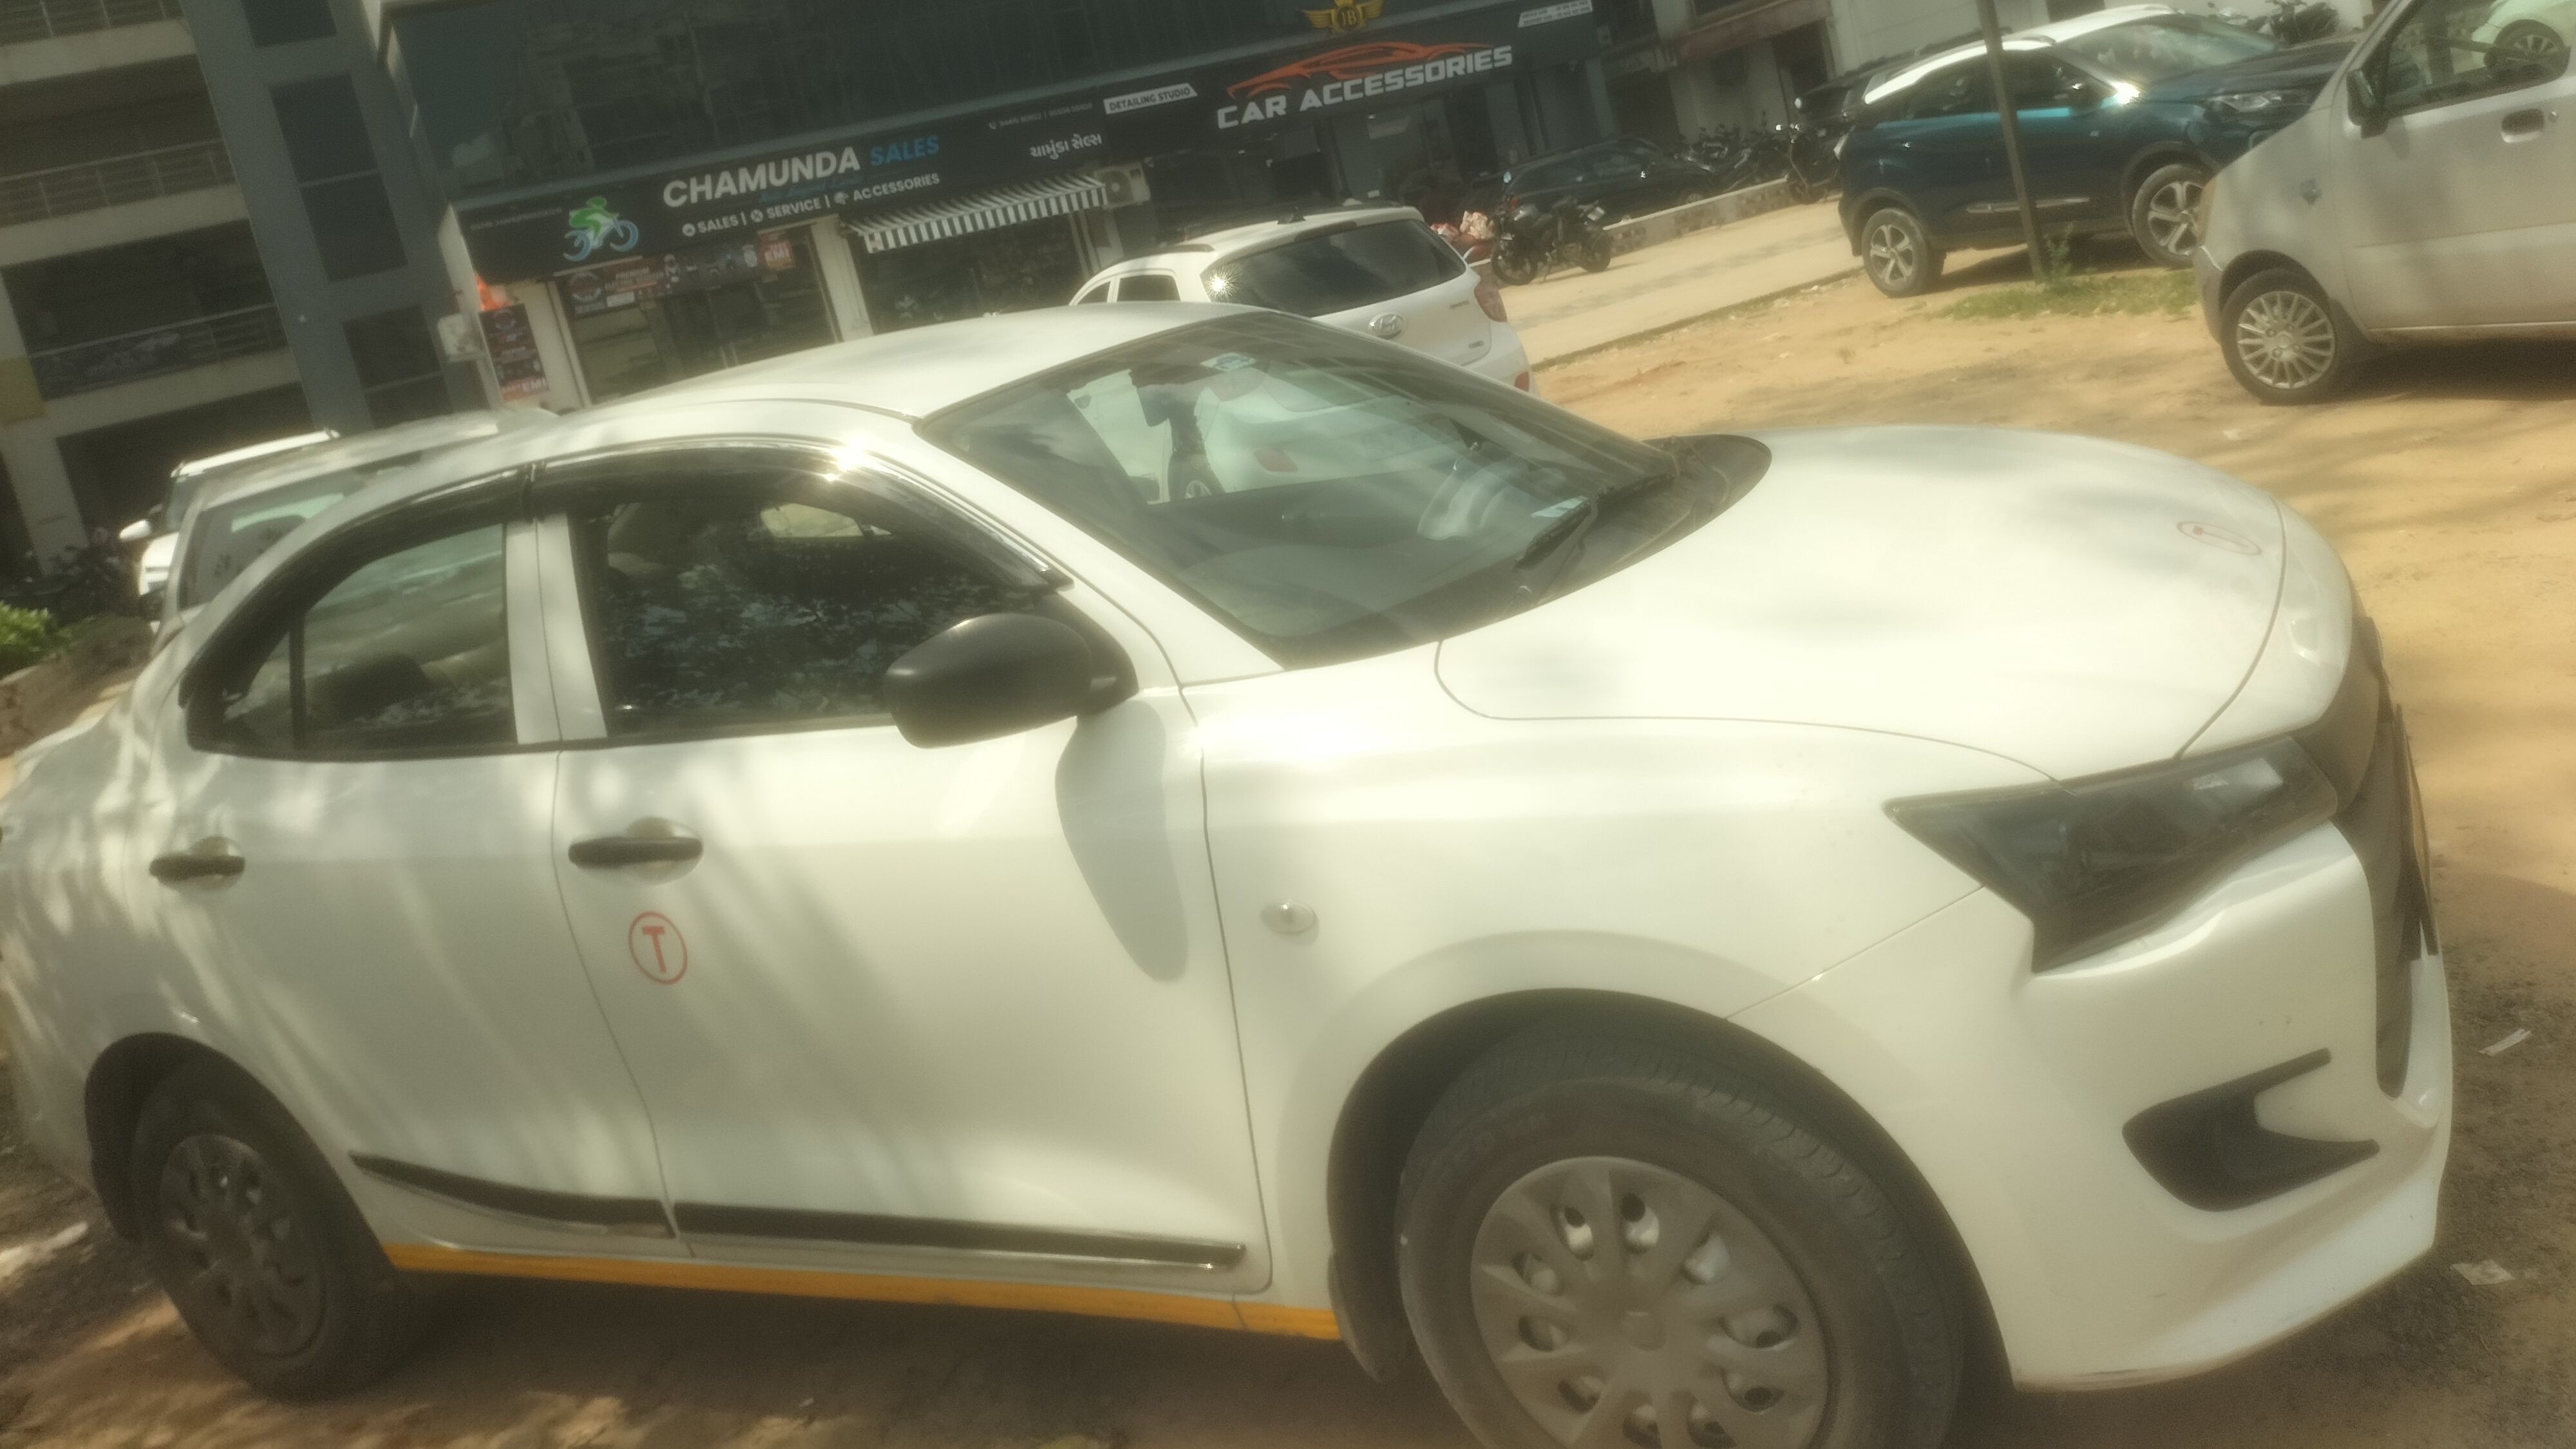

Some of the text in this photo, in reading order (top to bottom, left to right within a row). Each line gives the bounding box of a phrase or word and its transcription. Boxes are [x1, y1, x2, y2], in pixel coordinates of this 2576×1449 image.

[1109, 87, 1191, 111] DETAILING STUDIO
[1217, 45, 1512, 129] CAR ACCESSORIES
[1071, 133, 1102, 149] સેલ્સ
[663, 146, 861, 207] CHAMUNDA
[870, 136, 940, 166] SALES
[697, 214, 739, 234] SALES
[766, 196, 822, 219] SERVICE
[853, 172, 940, 202] ACCESSORIES
[641, 925, 666, 973] T
